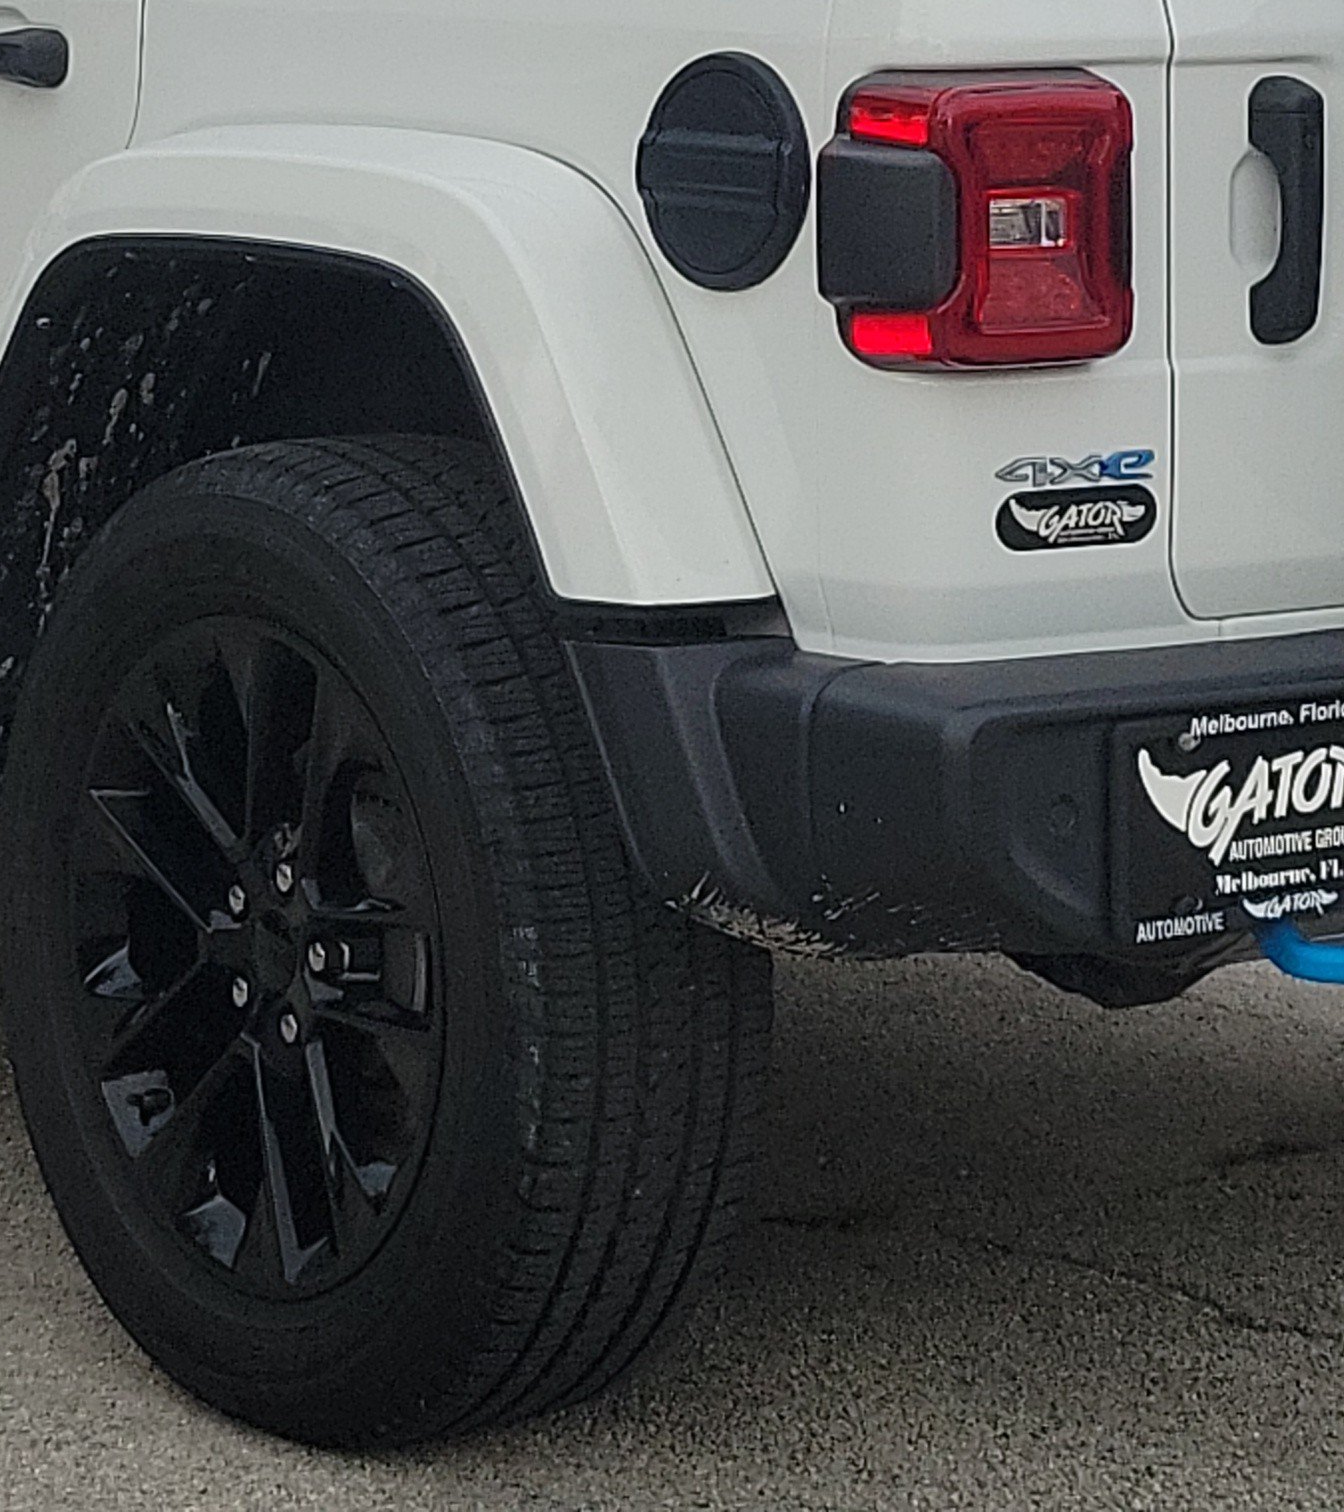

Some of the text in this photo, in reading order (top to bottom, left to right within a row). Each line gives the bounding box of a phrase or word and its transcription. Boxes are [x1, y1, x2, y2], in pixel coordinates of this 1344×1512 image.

[1038, 500, 1126, 543] GATOR
[1228, 833, 1312, 862] AUTOMOTIVE
[1136, 912, 1225, 943] AUTOMOTIVE
[1265, 889, 1324, 919] GATOR
